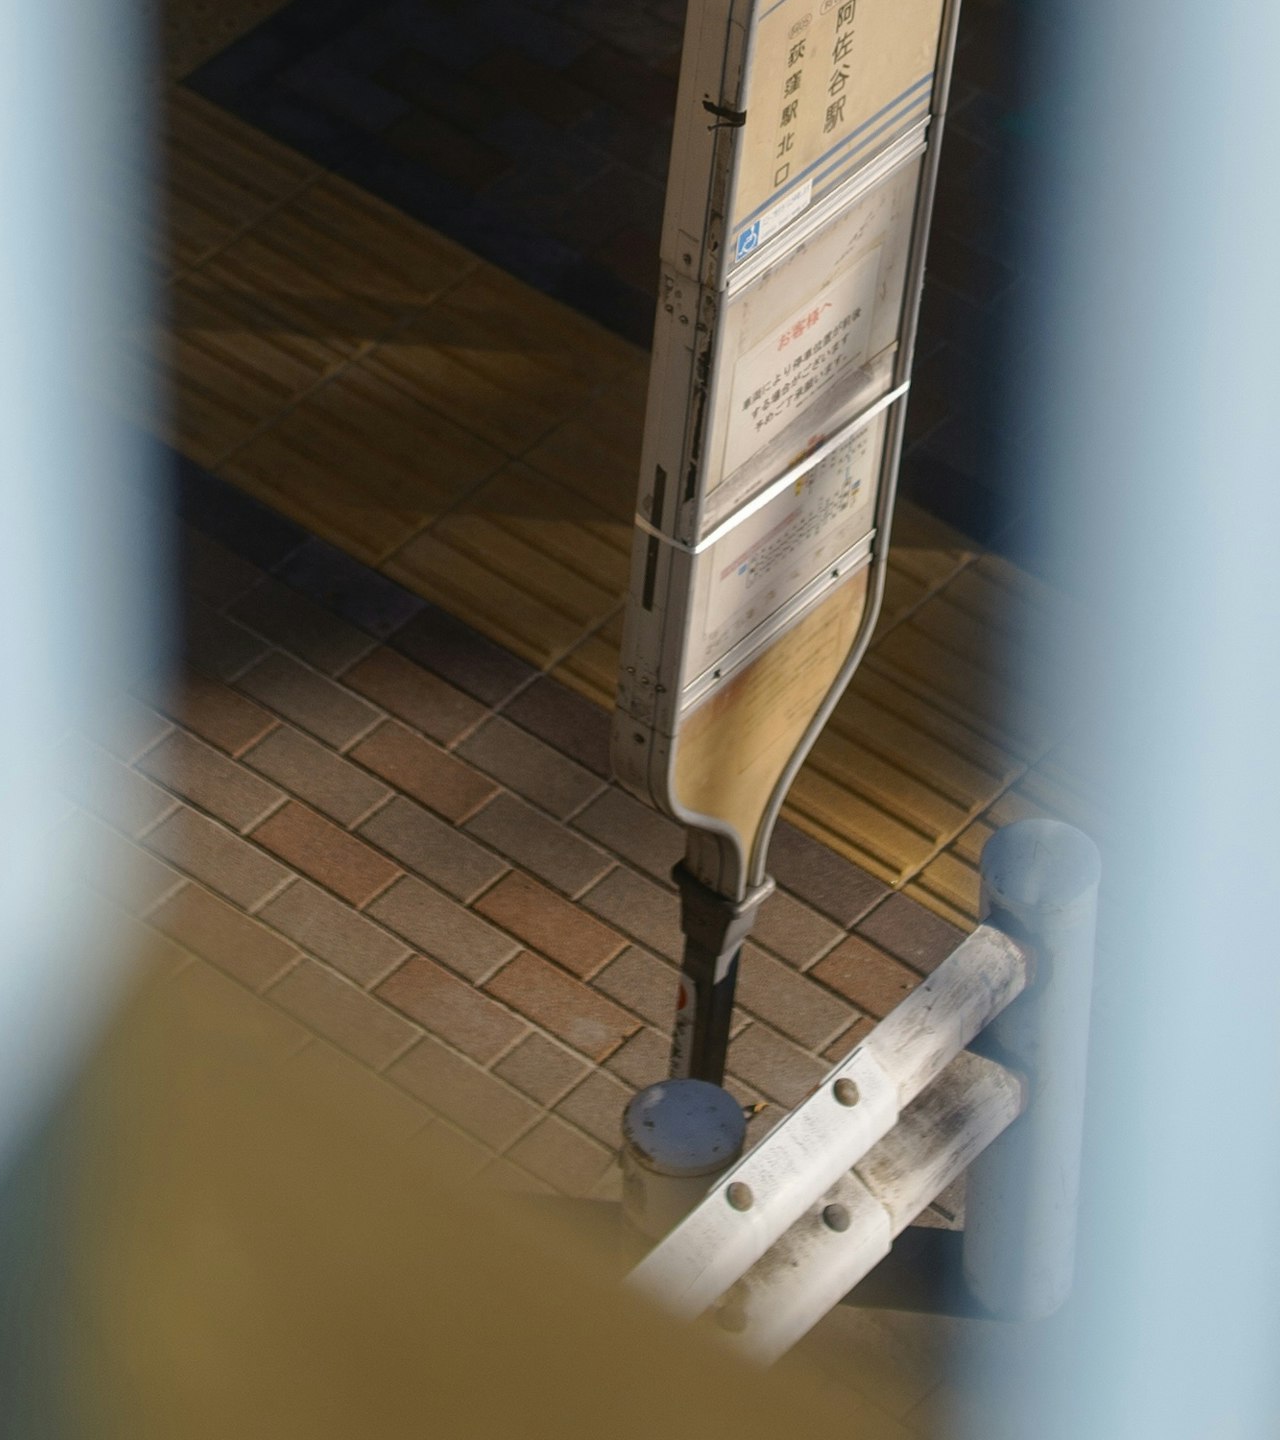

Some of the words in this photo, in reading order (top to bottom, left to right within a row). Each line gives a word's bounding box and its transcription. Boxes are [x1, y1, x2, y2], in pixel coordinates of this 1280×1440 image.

[774, 39, 806, 187] 荻窪駅北口
